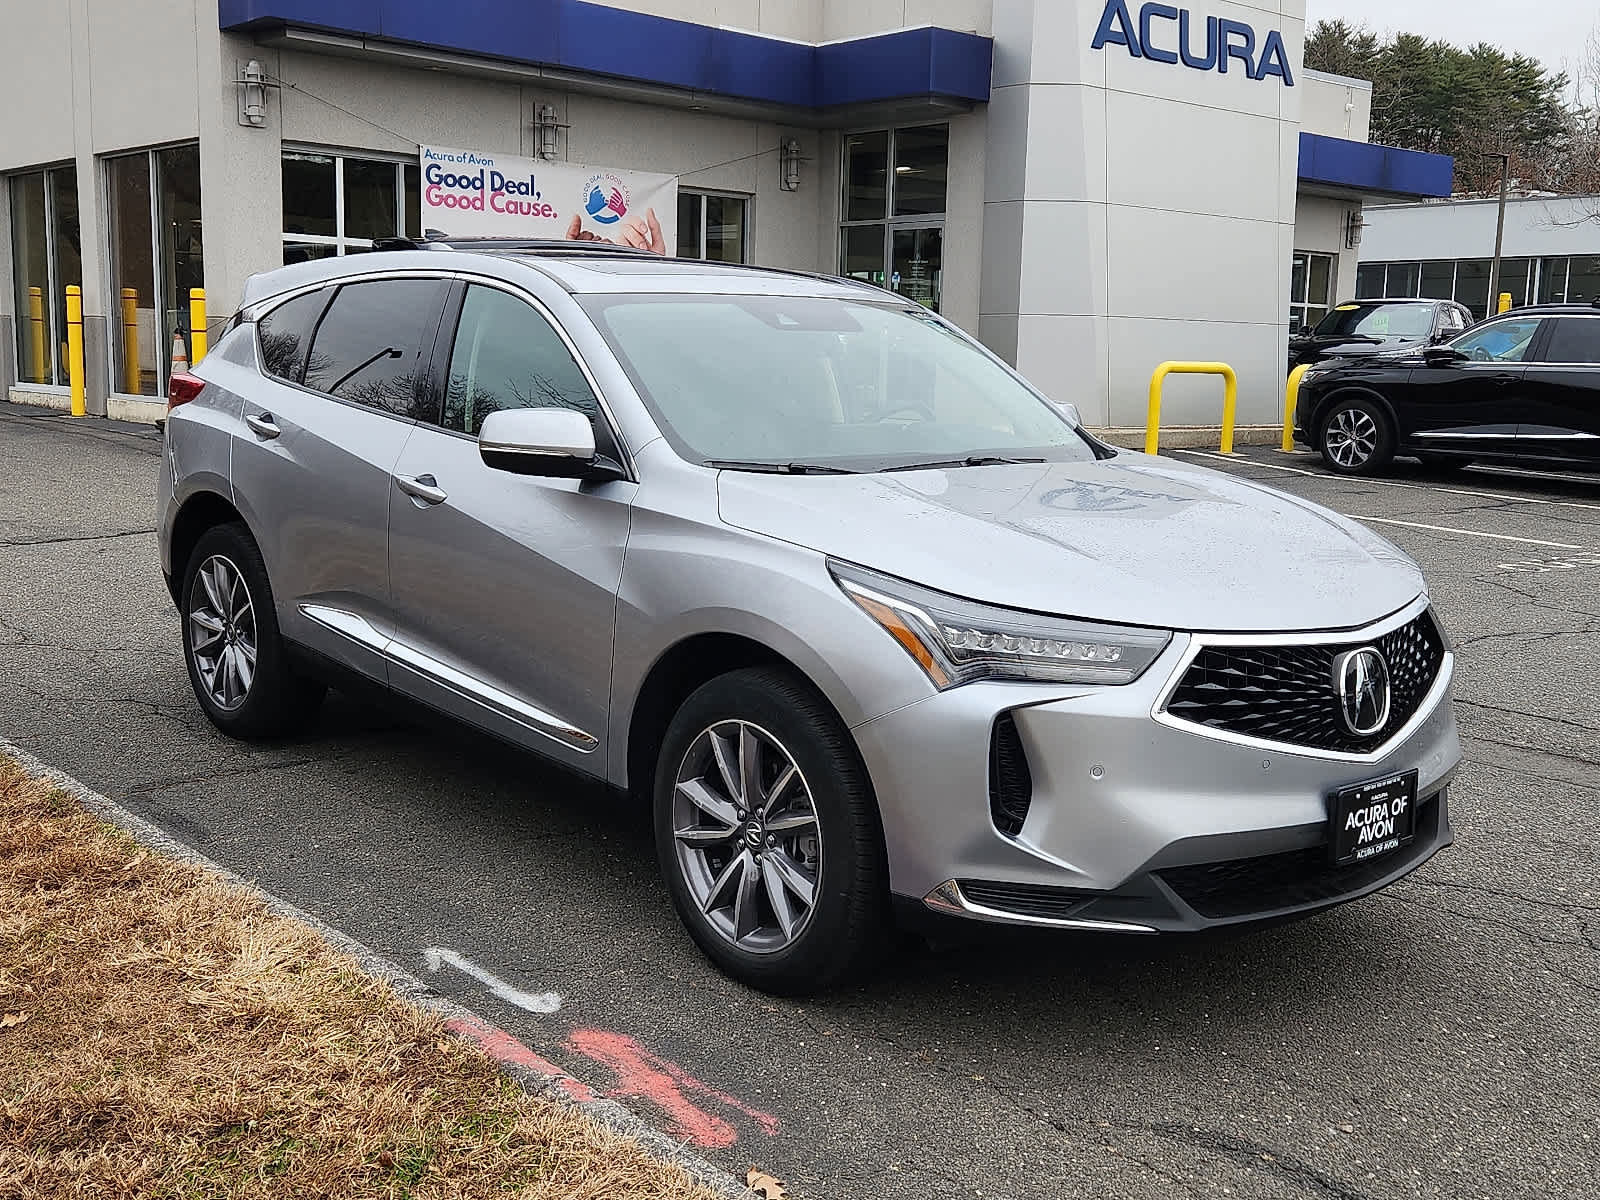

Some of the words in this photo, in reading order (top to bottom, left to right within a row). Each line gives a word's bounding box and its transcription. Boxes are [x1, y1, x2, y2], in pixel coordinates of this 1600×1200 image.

[1091, 0, 1294, 87] ACURA
[424, 149, 455, 163] Acura
[456, 153, 467, 164] of
[468, 154, 494, 167] Avon
[425, 163, 485, 190] Good
[489, 170, 541, 200] Deal,
[425, 183, 485, 212] Good
[489, 191, 558, 219] Cause.
[1344, 802, 1389, 831] ACURA
[1391, 795, 1408, 816] OF
[1357, 817, 1395, 845] AVON
[1356, 847, 1375, 859] ACURA
[1375, 845, 1384, 853] OF
[1384, 839, 1399, 850] AVON
